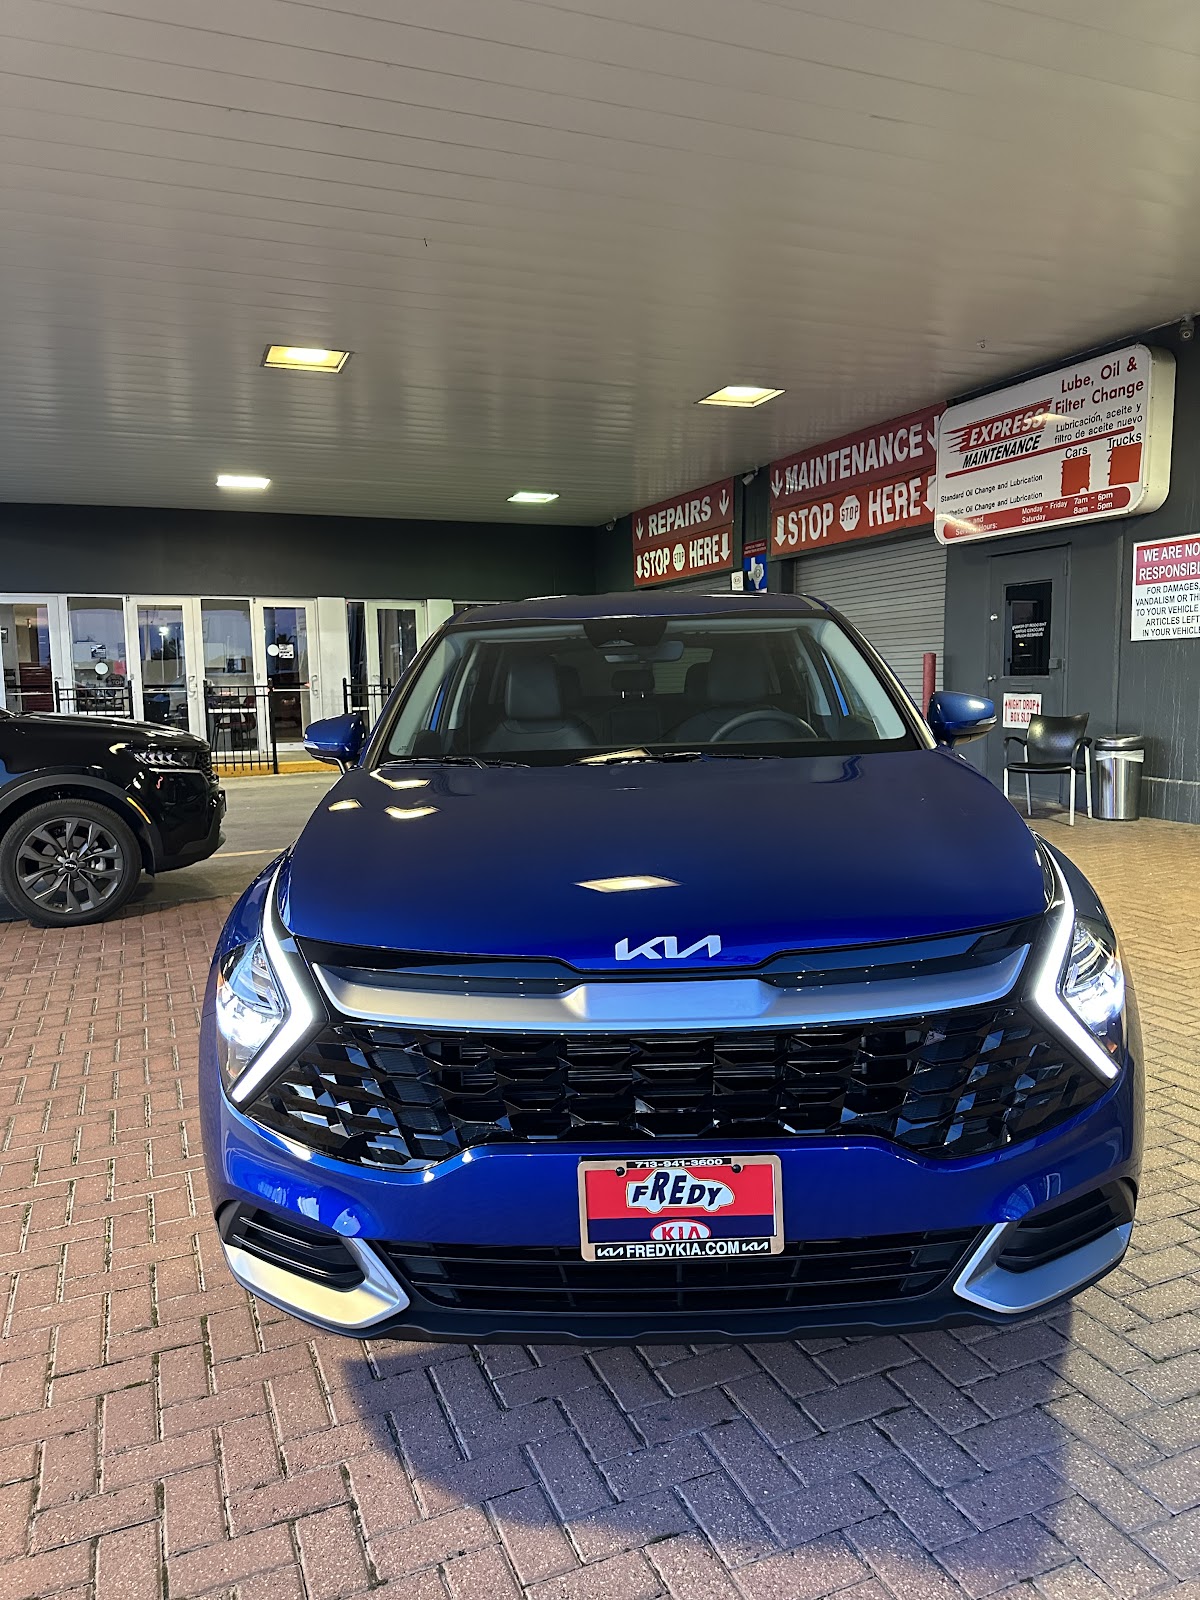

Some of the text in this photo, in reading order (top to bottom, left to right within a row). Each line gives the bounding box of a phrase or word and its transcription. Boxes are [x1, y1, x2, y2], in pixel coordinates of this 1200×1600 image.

[1061, 356, 1137, 393] Lube, Oil &
[1055, 380, 1144, 415] Filter Change
[969, 407, 1046, 447] EXPRESS
[1054, 415, 1143, 444] filtro de aceite nuevo
[1056, 403, 1142, 433] Lubricación, aceite y
[962, 434, 1042, 469] MAINTENANCE
[1107, 432, 1142, 449] Trucks
[785, 423, 923, 495] MAINTENANCE
[1065, 445, 1088, 460] Cars
[940, 491, 964, 503] Standard
[974, 485, 995, 496] Change
[997, 481, 1008, 490] and
[1010, 474, 1043, 487] Lubrication
[788, 477, 922, 545] STOP STOP HERE
[974, 501, 995, 511] Change
[997, 498, 1008, 507] and
[1010, 491, 1043, 504] Lubrication
[1021, 505, 1044, 515] Monday
[1050, 501, 1068, 510] Friday
[1074, 497, 1088, 505] 7am
[1097, 492, 1113, 501] 6pm
[1021, 514, 1046, 524] Saturday
[1073, 506, 1088, 514] 8am
[1097, 501, 1113, 511] 5pm
[648, 496, 712, 537] REPAIRS
[643, 534, 720, 578] STOP STOP HERE
[1143, 548, 1159, 562] WE
[1161, 545, 1182, 560] ARE
[1135, 595, 1175, 606] VANDALISM
[1176, 594, 1188, 603] OR
[1146, 586, 1161, 595] FOR
[1136, 604, 1199, 616] TO YOUR VEHICLE
[1145, 615, 1200, 626] ARTICLES LEFT
[1142, 629, 1149, 637] IN
[1150, 628, 1171, 636] YOUR
[1007, 699, 1037, 710] NIGHT DROP
[1010, 712, 1031, 722] BOX SLO
[614, 934, 722, 961] KIA
[634, 1158, 724, 1168] 713-941-3600
[632, 1171, 723, 1207] FREDY
[661, 1225, 701, 1241] KIA
[597, 1241, 769, 1259] KIA FREDYKIA.COM KIA
